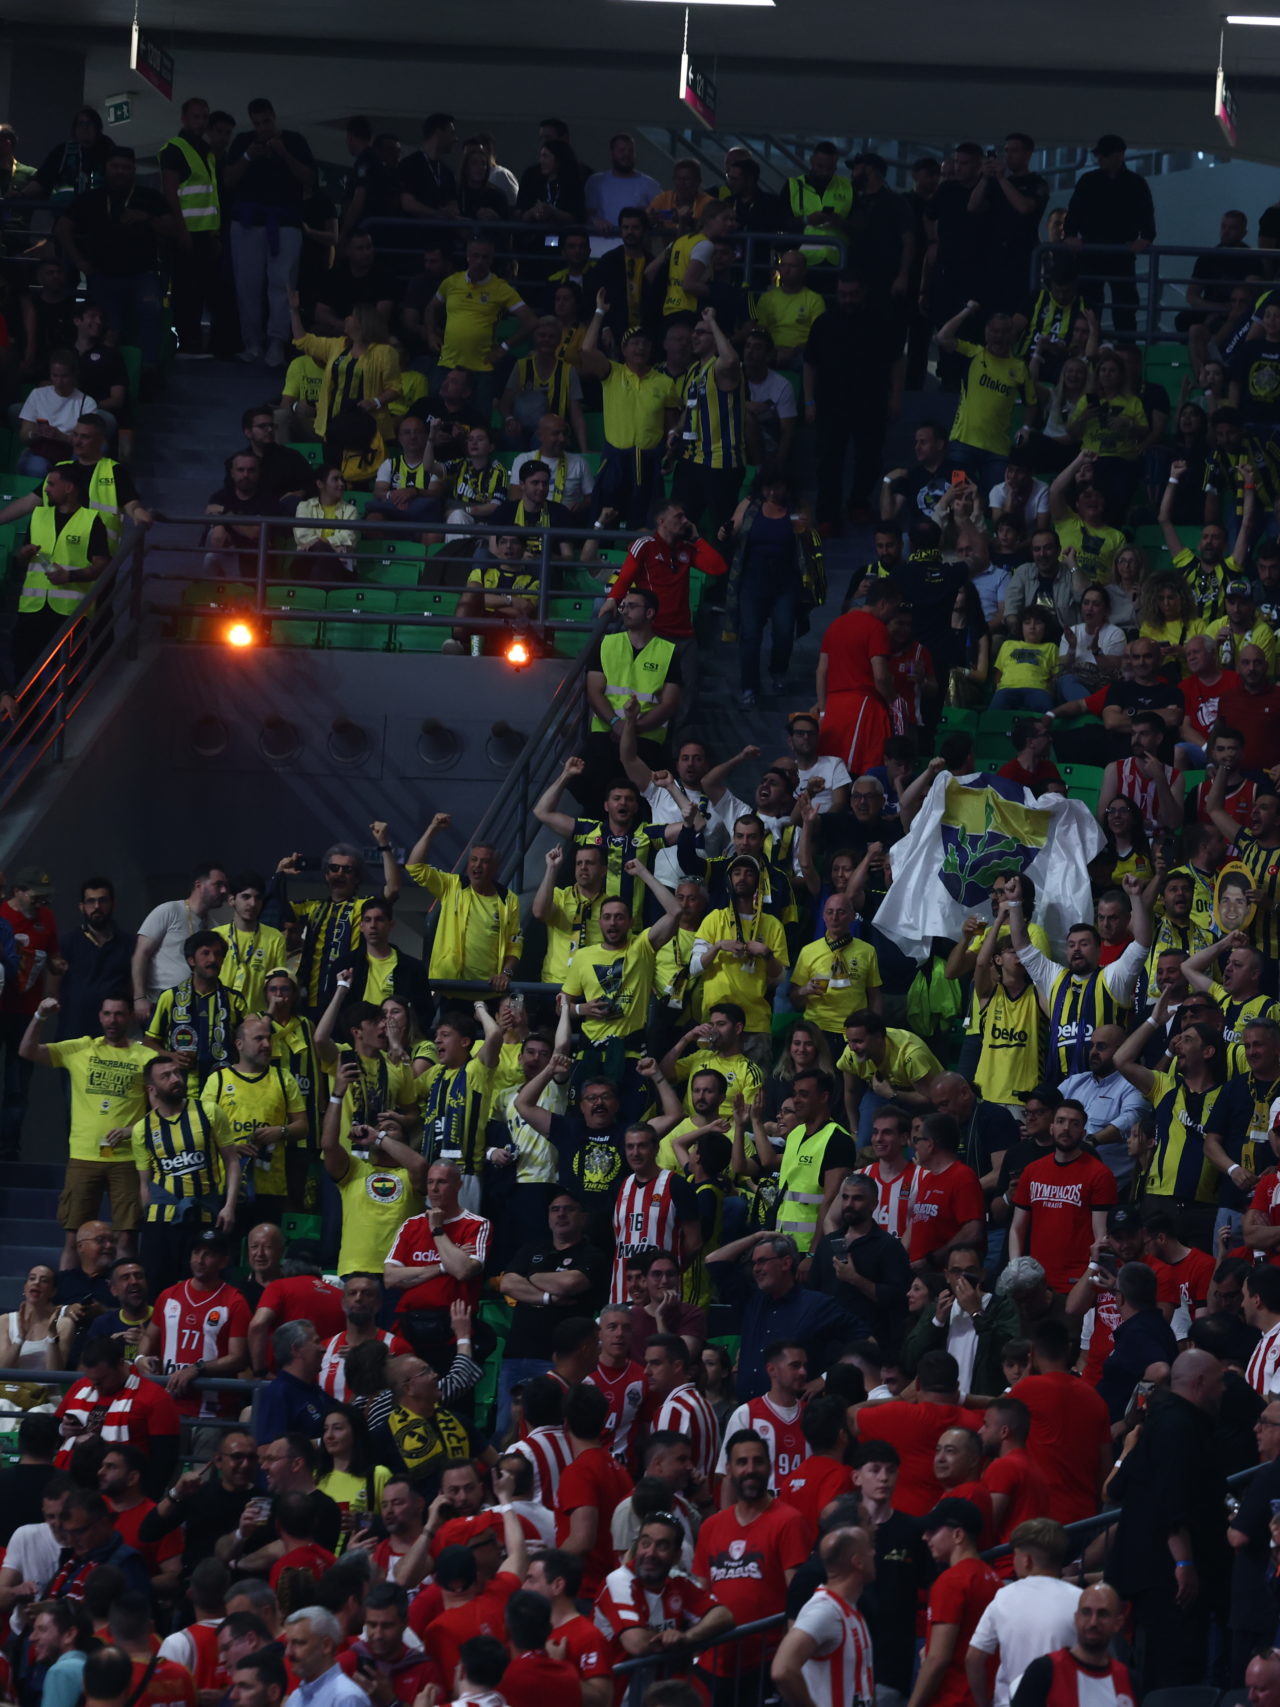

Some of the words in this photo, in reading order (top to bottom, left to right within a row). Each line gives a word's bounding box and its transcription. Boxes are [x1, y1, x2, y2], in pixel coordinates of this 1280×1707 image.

[643, 661, 659, 671] CSI
[990, 1022, 1029, 1044] beko
[160, 1150, 206, 1172] beko
[799, 1155, 814, 1164] CSI
[631, 1213, 645, 1232] 16
[180, 1328, 201, 1351] 77
